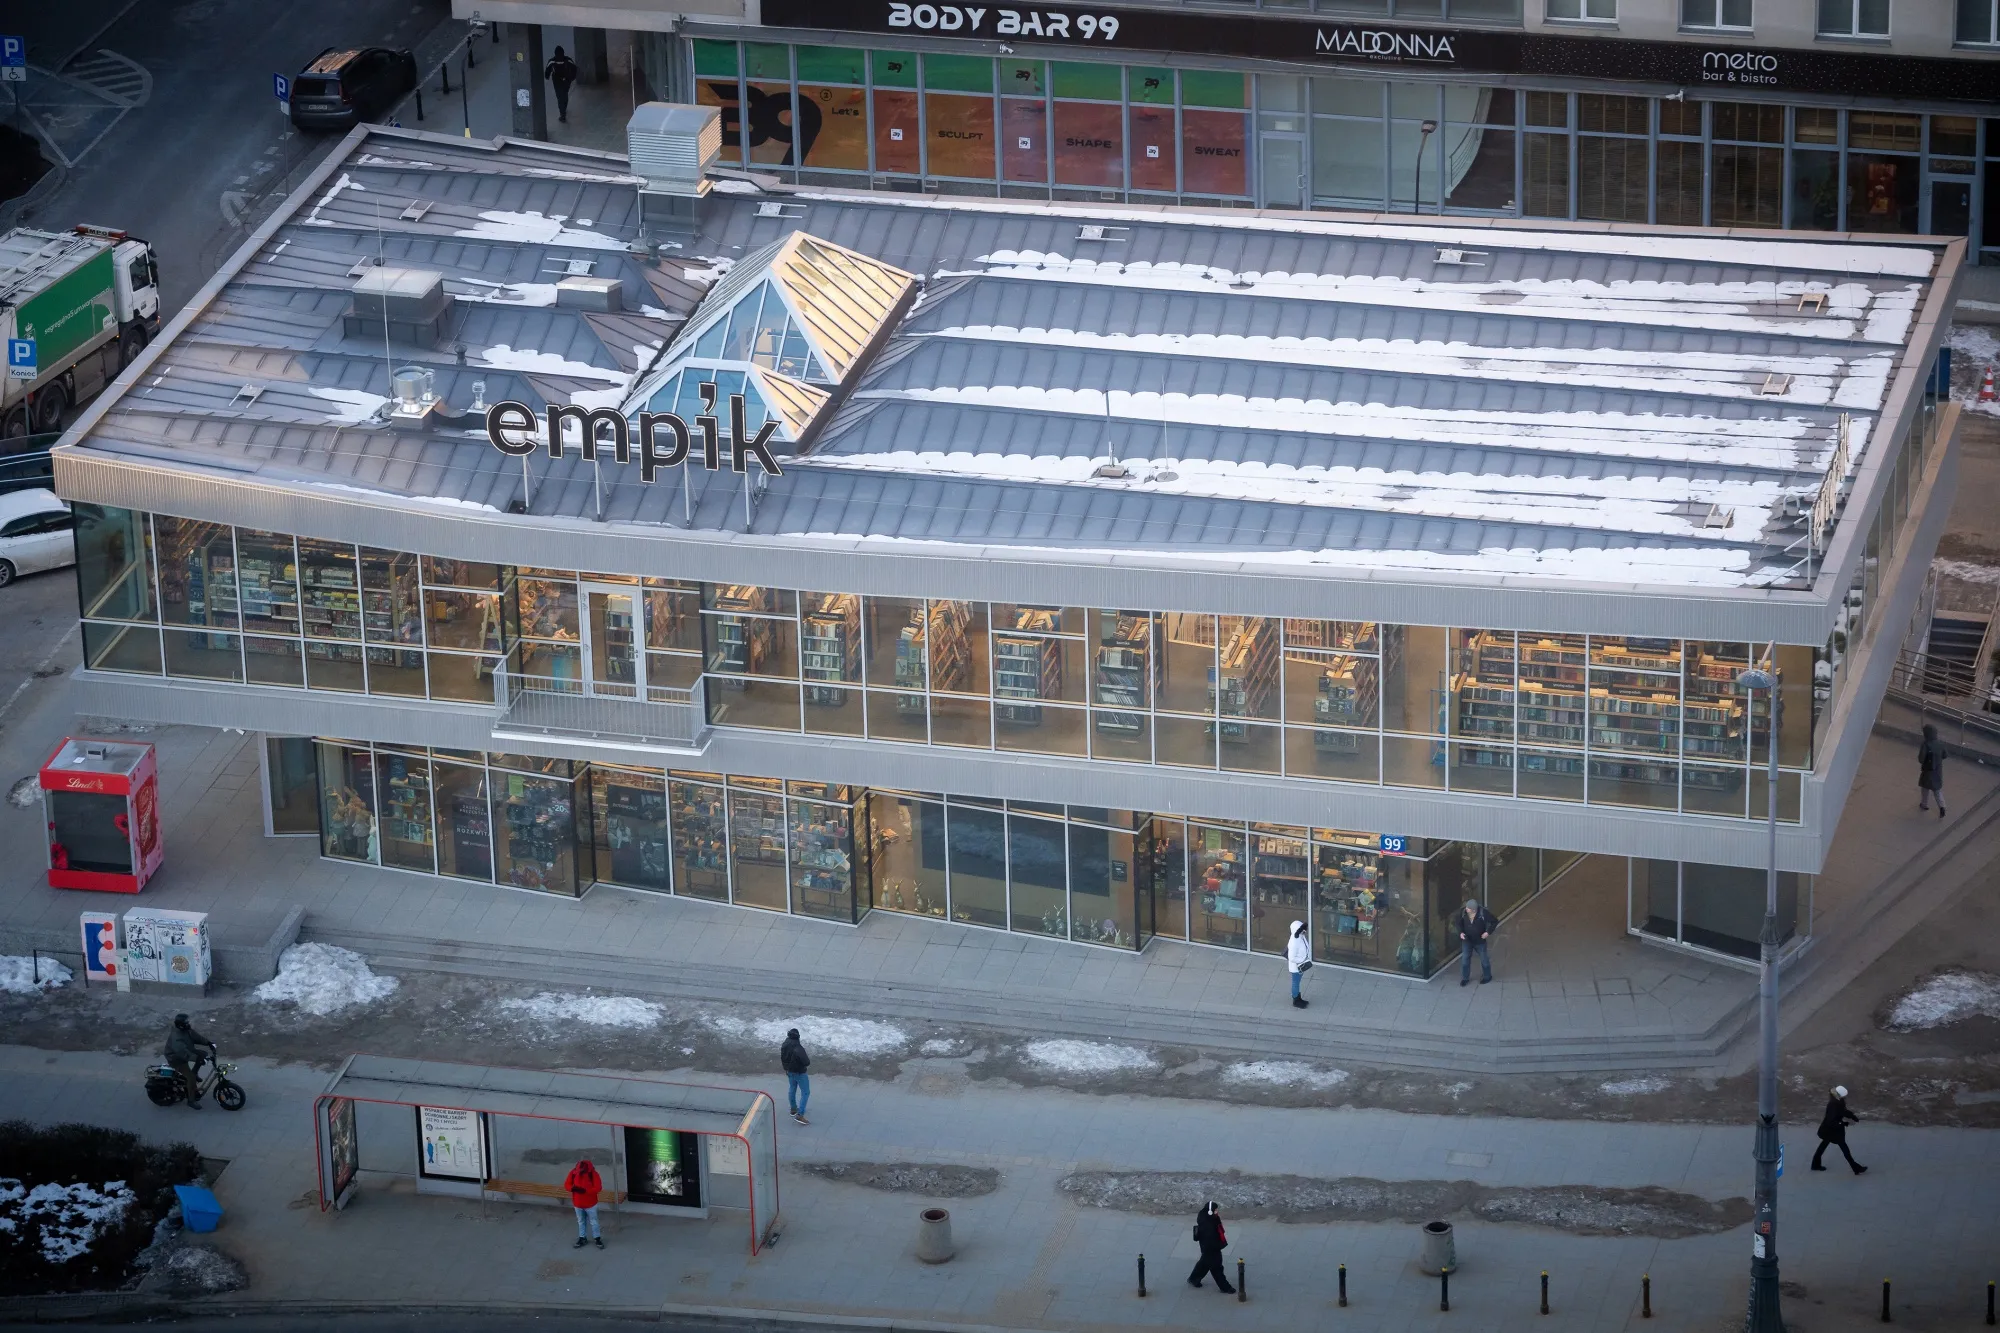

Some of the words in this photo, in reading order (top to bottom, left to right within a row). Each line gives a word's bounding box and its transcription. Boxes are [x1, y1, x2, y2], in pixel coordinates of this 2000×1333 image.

[888, 2, 987, 31] BODY
[997, 9, 1070, 38] BAR
[1077, 14, 1119, 40] 99
[4, 38, 19, 58] P
[1316, 28, 1454, 58] MADONNA
[1703, 52, 1777, 71] metro
[1703, 70, 1724, 80] bar
[1727, 71, 1736, 81] &
[1741, 73, 1777, 84] bistro
[276, 76, 286, 96] P
[831, 107, 859, 117] Let's
[938, 130, 984, 140] SCULPT
[1066, 138, 1112, 149] SHAPE
[1194, 146, 1240, 157] SWEAT
[15, 342, 30, 362] P
[11, 369, 36, 377] Koniec
[486, 382, 784, 483] empik
[66, 777, 96, 789] Lindt
[1384, 837, 1401, 851] 99
